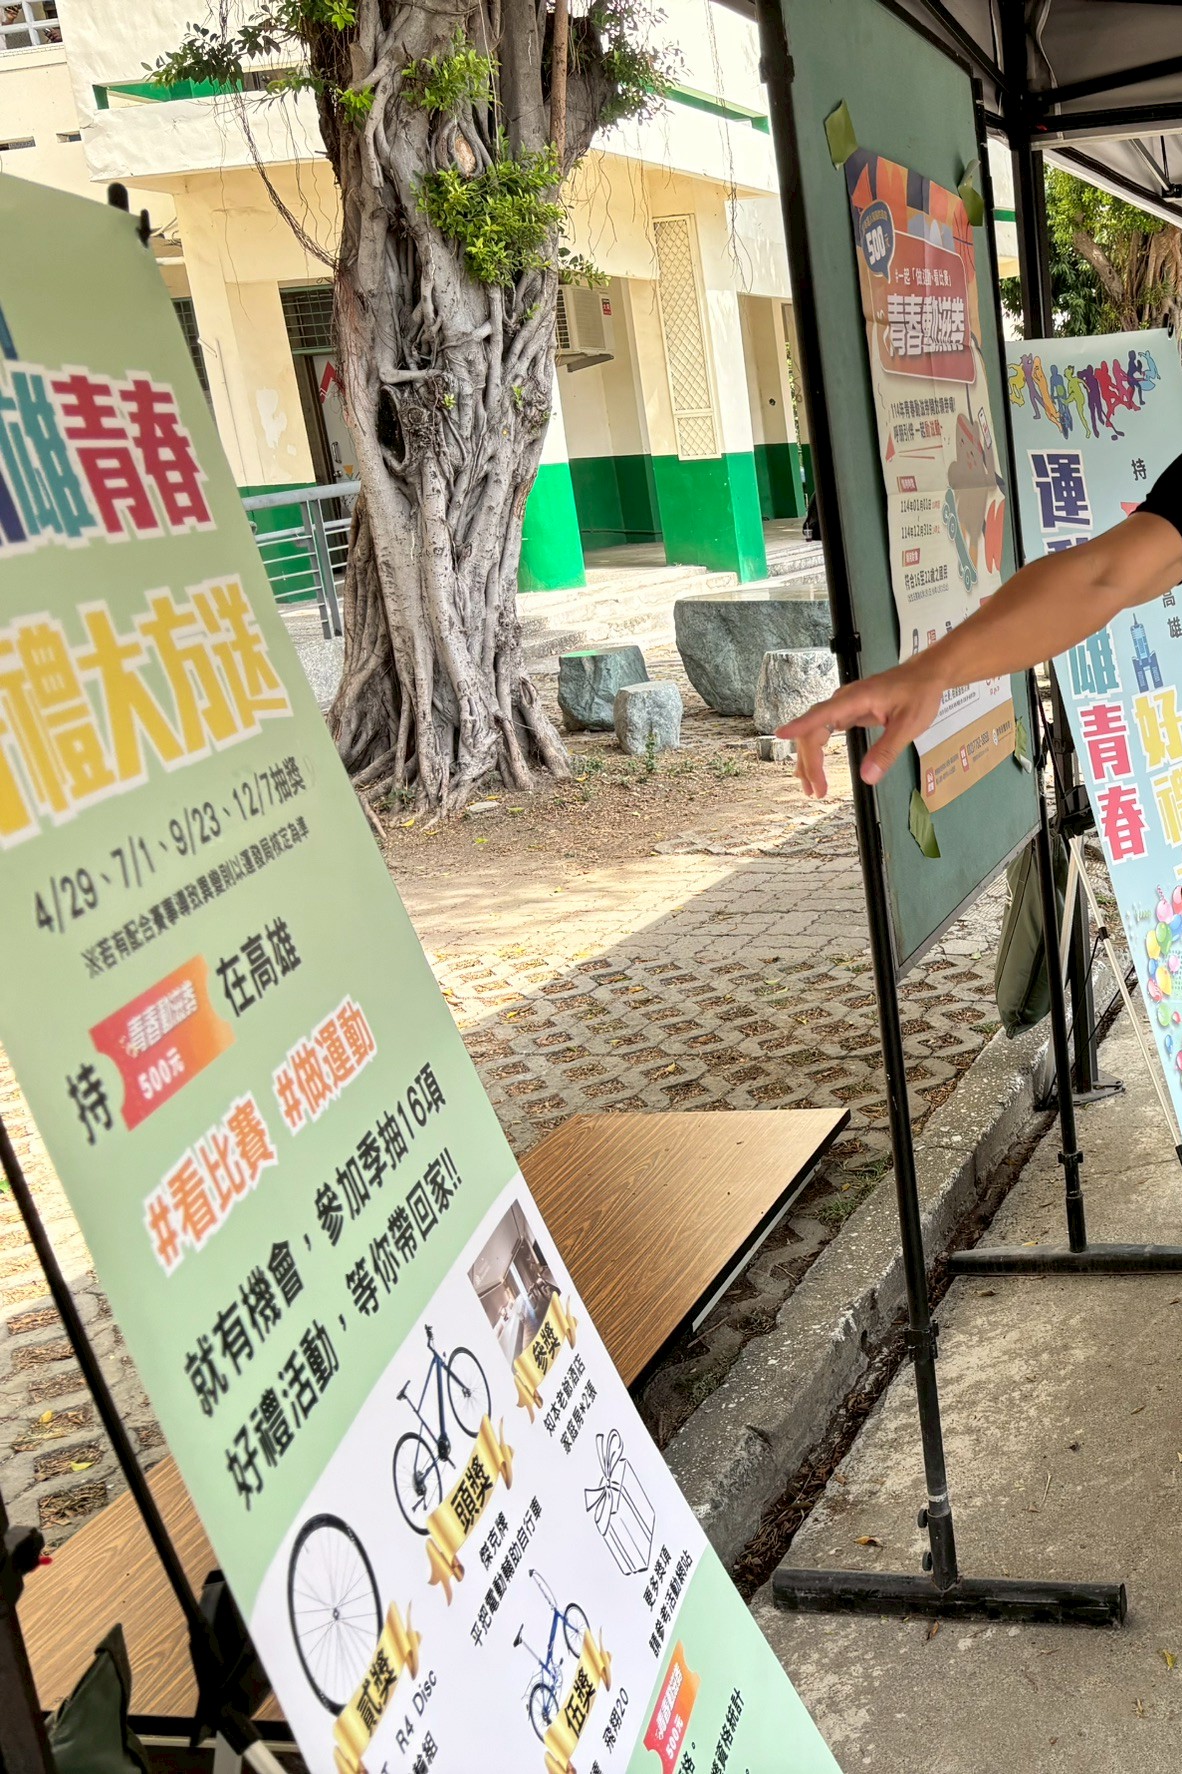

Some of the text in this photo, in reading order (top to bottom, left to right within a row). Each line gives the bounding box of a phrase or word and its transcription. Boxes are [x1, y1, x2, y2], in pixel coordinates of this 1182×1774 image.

[887, 293, 965, 357] 青春動滋券
[0, 363, 215, 553] 雄青春
[1130, 458, 1147, 482] 持
[66, 916, 302, 1146] 持 500元 在高雄
[146, 997, 377, 1273] #看比賽 #做運動
[532, 1320, 561, 1376] 參獎
[450, 1454, 493, 1535] 頭獎
[478, 1510, 509, 1571] 傑克牌
[356, 1647, 397, 1738] 貳獎
[395, 1670, 438, 1755] R4 Disc
[564, 1666, 597, 1739] 伍獎
[602, 1687, 629, 1754] 飛翔20
[665, 1713, 684, 1759] 500元
